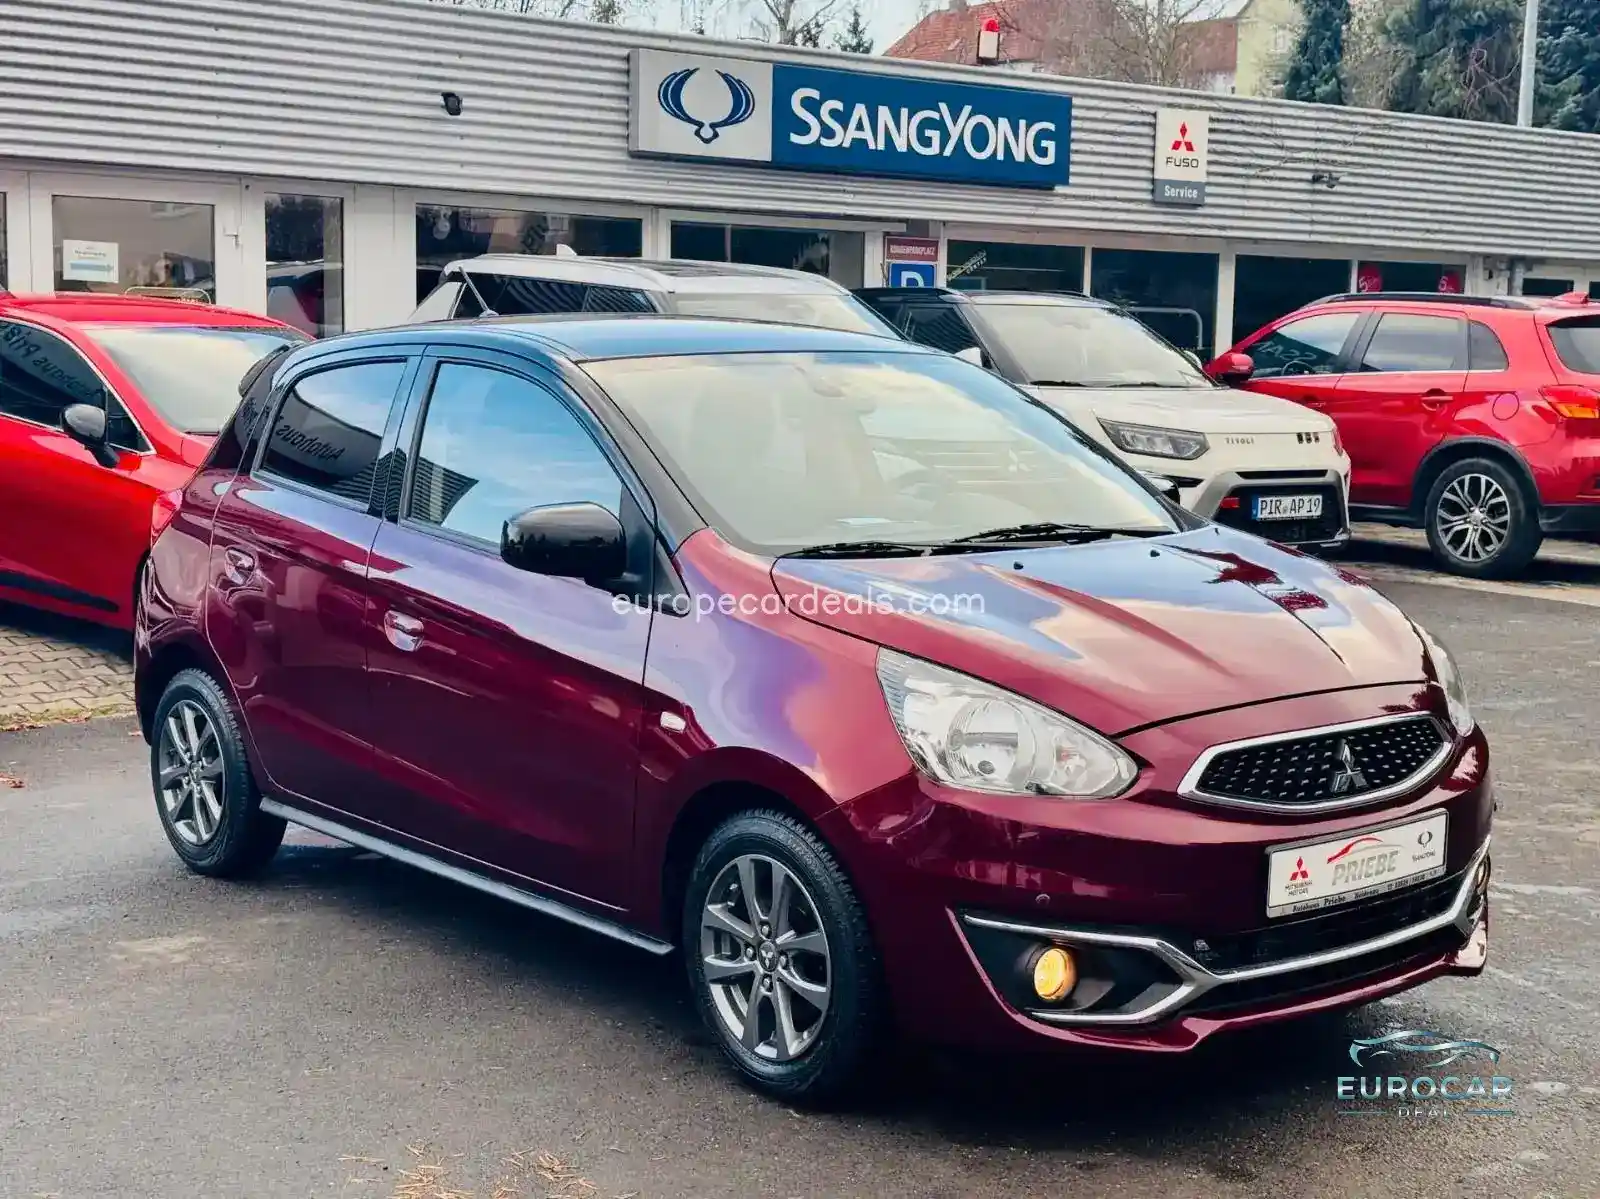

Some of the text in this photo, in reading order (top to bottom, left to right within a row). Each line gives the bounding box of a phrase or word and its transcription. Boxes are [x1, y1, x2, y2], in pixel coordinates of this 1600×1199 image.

[1166, 156, 1199, 168] FUSO
[1164, 185, 1198, 199] Service
[1225, 437, 1254, 445] TIVOLI
[1260, 500, 1281, 516] PIR
[1332, 851, 1400, 886] PRIEBE
